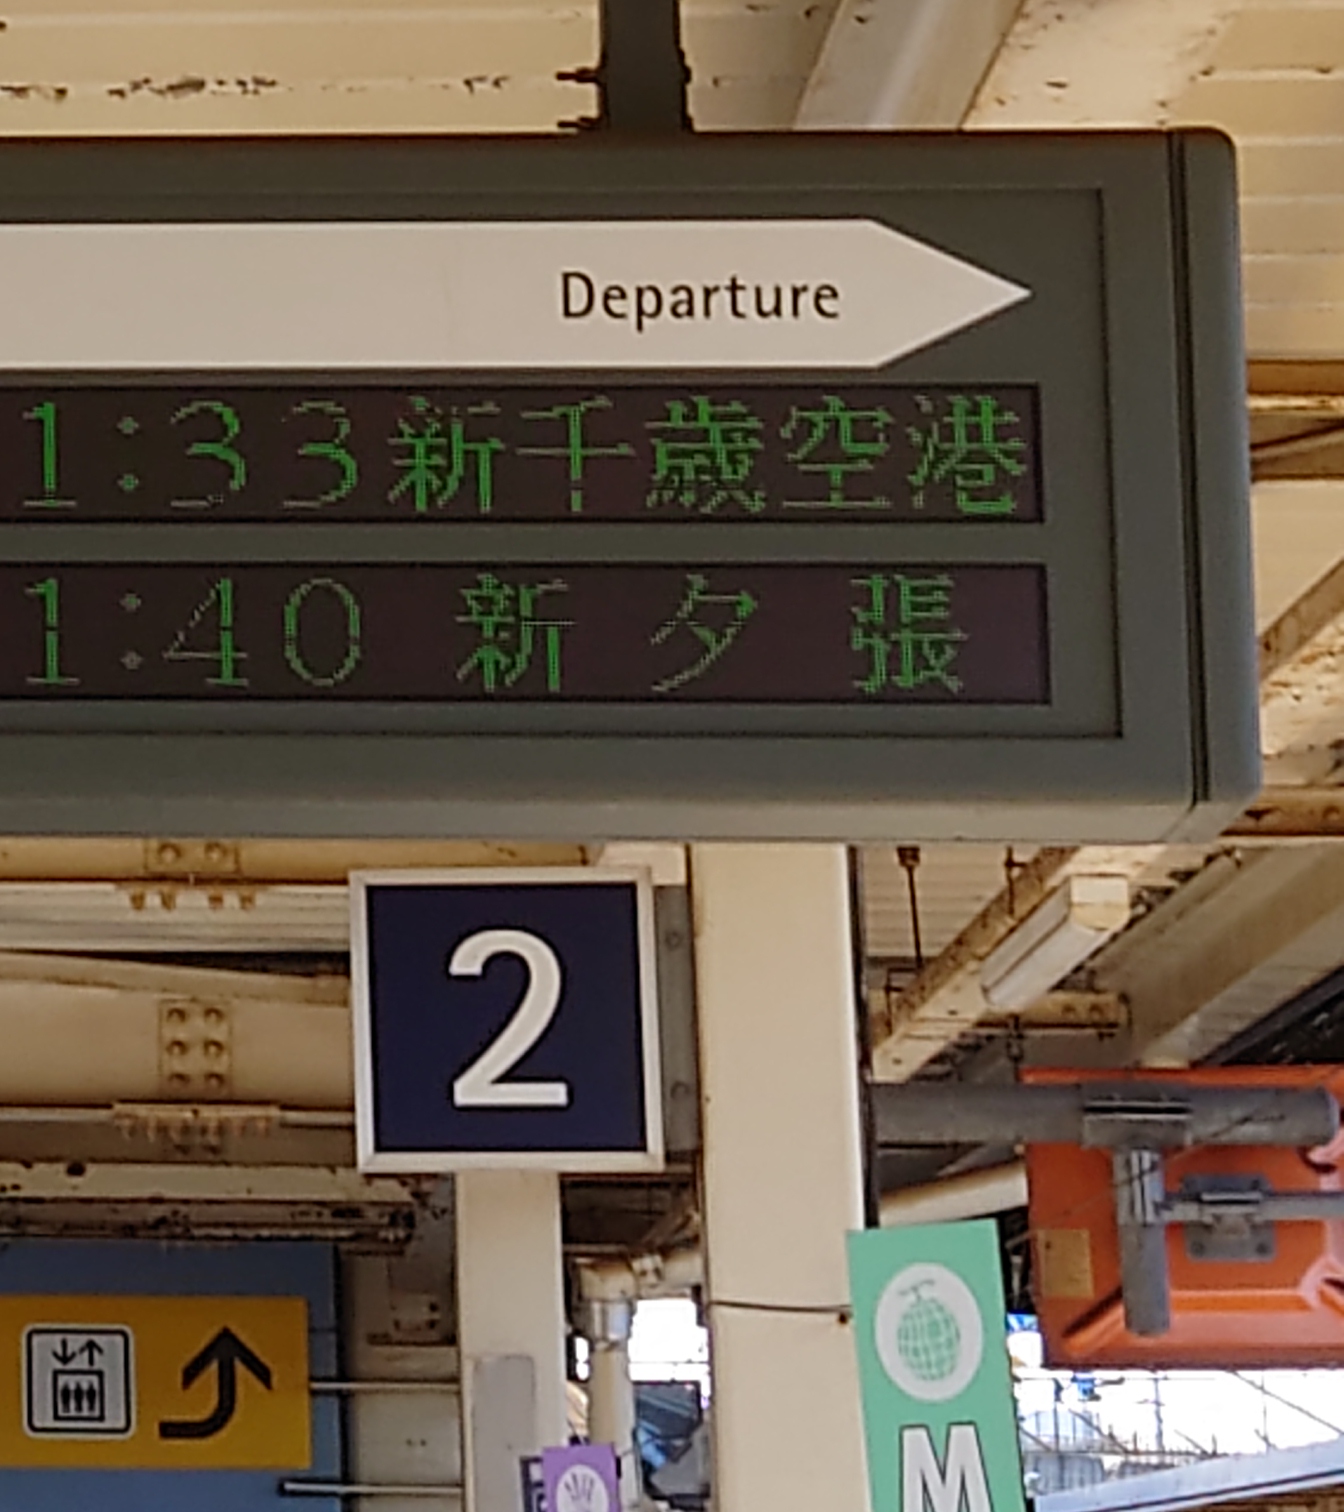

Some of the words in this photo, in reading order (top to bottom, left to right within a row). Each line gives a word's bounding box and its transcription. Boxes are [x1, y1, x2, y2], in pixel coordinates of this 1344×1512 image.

[558, 269, 842, 334] Departure
[387, 393, 1029, 515] 新千歳空港
[455, 572, 968, 694] 新夕張
[446, 928, 570, 1109] 2
[899, 1420, 996, 1512] M
